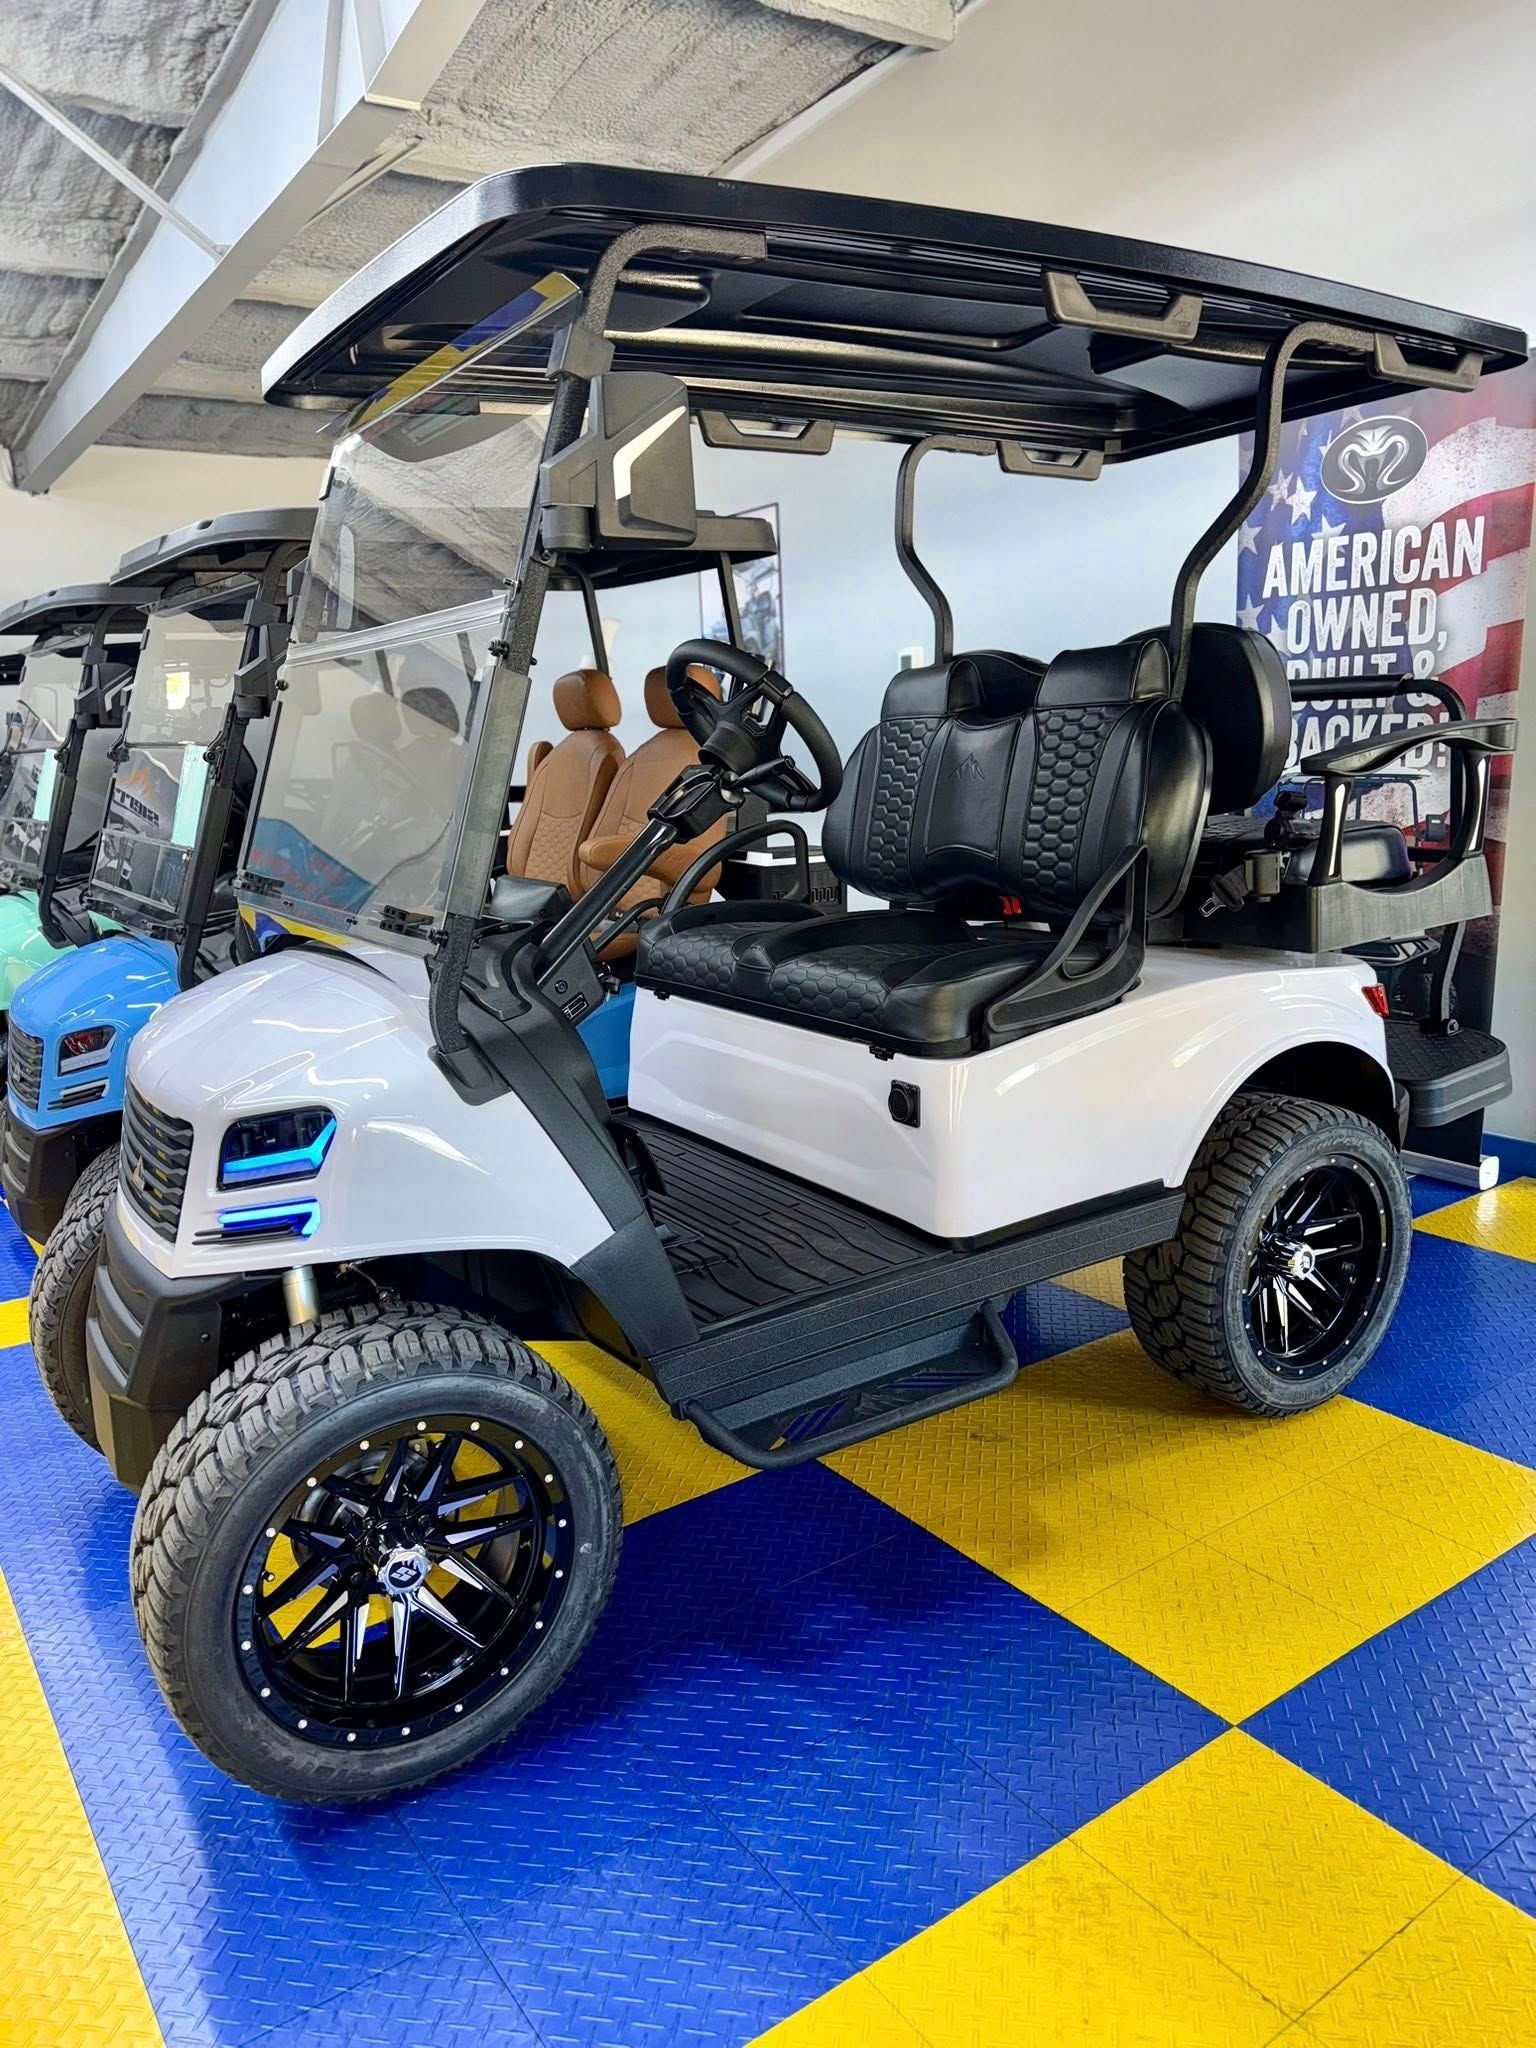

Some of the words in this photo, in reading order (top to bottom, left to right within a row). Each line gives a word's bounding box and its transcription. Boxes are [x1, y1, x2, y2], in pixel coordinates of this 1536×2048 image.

[1262, 515, 1485, 598] AMERICAN
[1286, 587, 1447, 654] OWNED,
[1406, 650, 1442, 707] &
